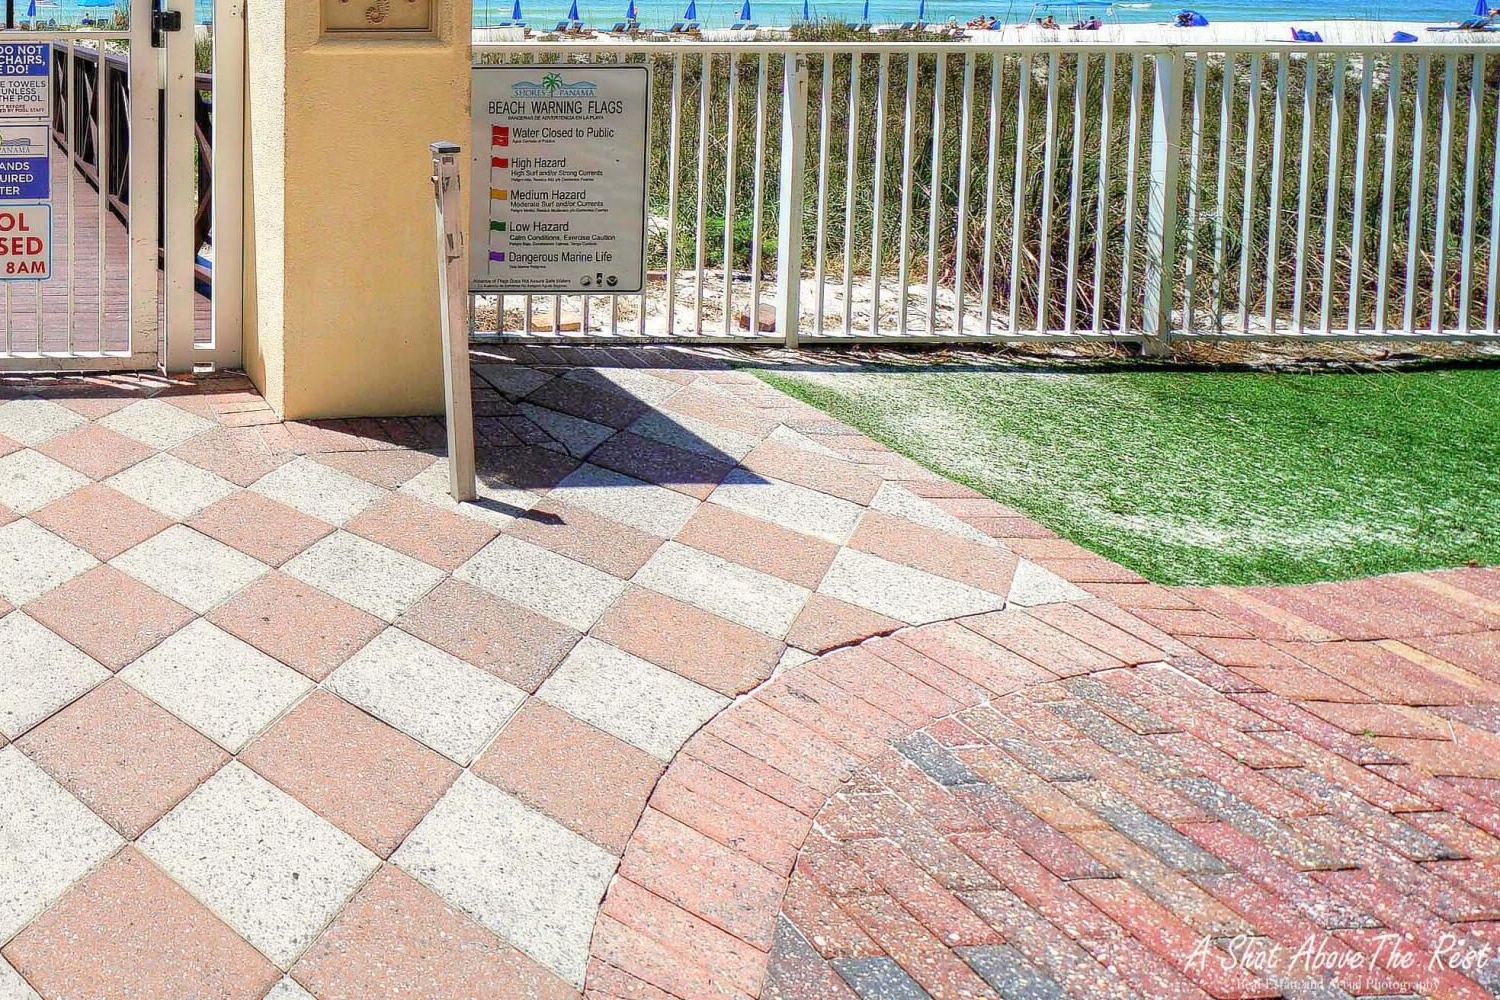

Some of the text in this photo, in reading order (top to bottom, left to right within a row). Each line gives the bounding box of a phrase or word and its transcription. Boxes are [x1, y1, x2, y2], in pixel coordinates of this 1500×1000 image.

[18, 45, 43, 54] NOT
[7, 65, 29, 74] DO!
[9, 80, 46, 88] TOWELS
[560, 89, 595, 97] PANAMA
[489, 101, 623, 114] BEACH WARNING FLAGS
[513, 127, 614, 138] Water Closed to Public
[511, 157, 566, 170] High Hazard
[510, 189, 586, 200] Medium Hazard
[509, 221, 569, 232] Low Hazard
[509, 251, 612, 264] Dangerous Marine Life
[6, 261, 46, 274] 8AM
